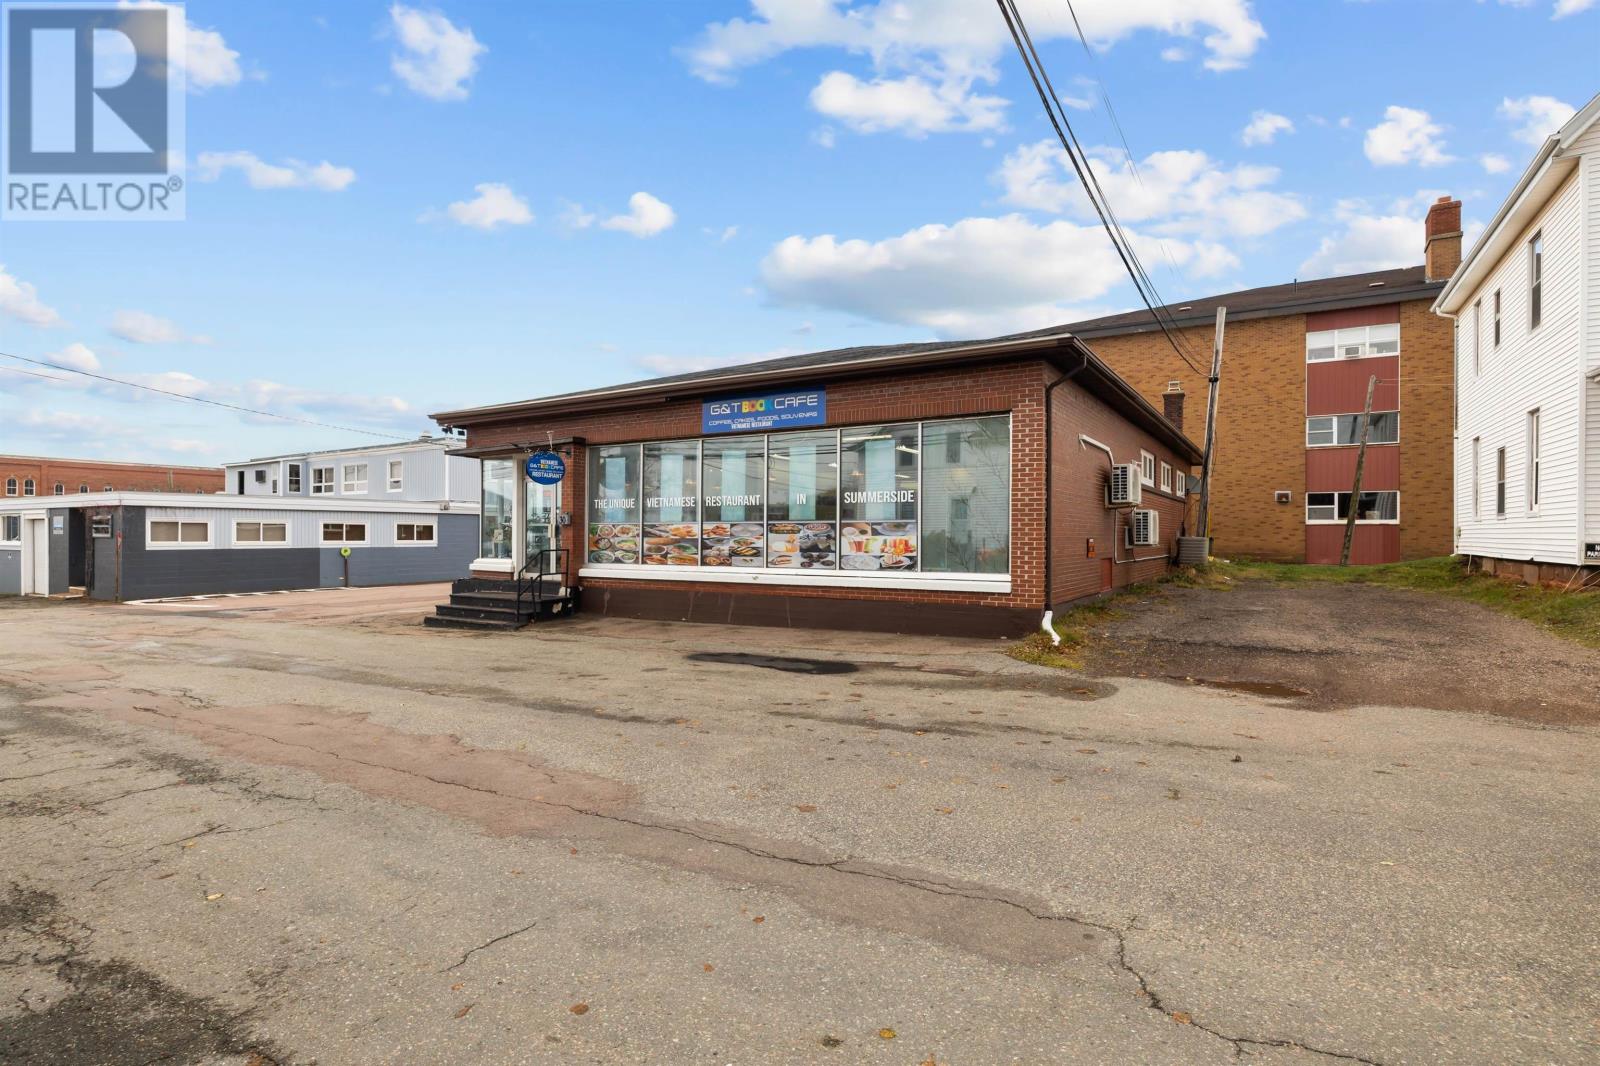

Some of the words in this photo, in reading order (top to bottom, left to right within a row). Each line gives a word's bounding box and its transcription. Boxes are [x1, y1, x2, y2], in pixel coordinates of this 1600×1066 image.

[774, 395, 818, 408] CAFE
[531, 471, 563, 479] RESTAURANT
[594, 499, 608, 509] THE
[608, 498, 635, 509] UNIQUE
[646, 496, 696, 508] VIETNAMESE
[705, 494, 761, 507] RESTAURANT
[796, 492, 807, 505] IN
[844, 490, 915, 504] SUMMERSIDE
